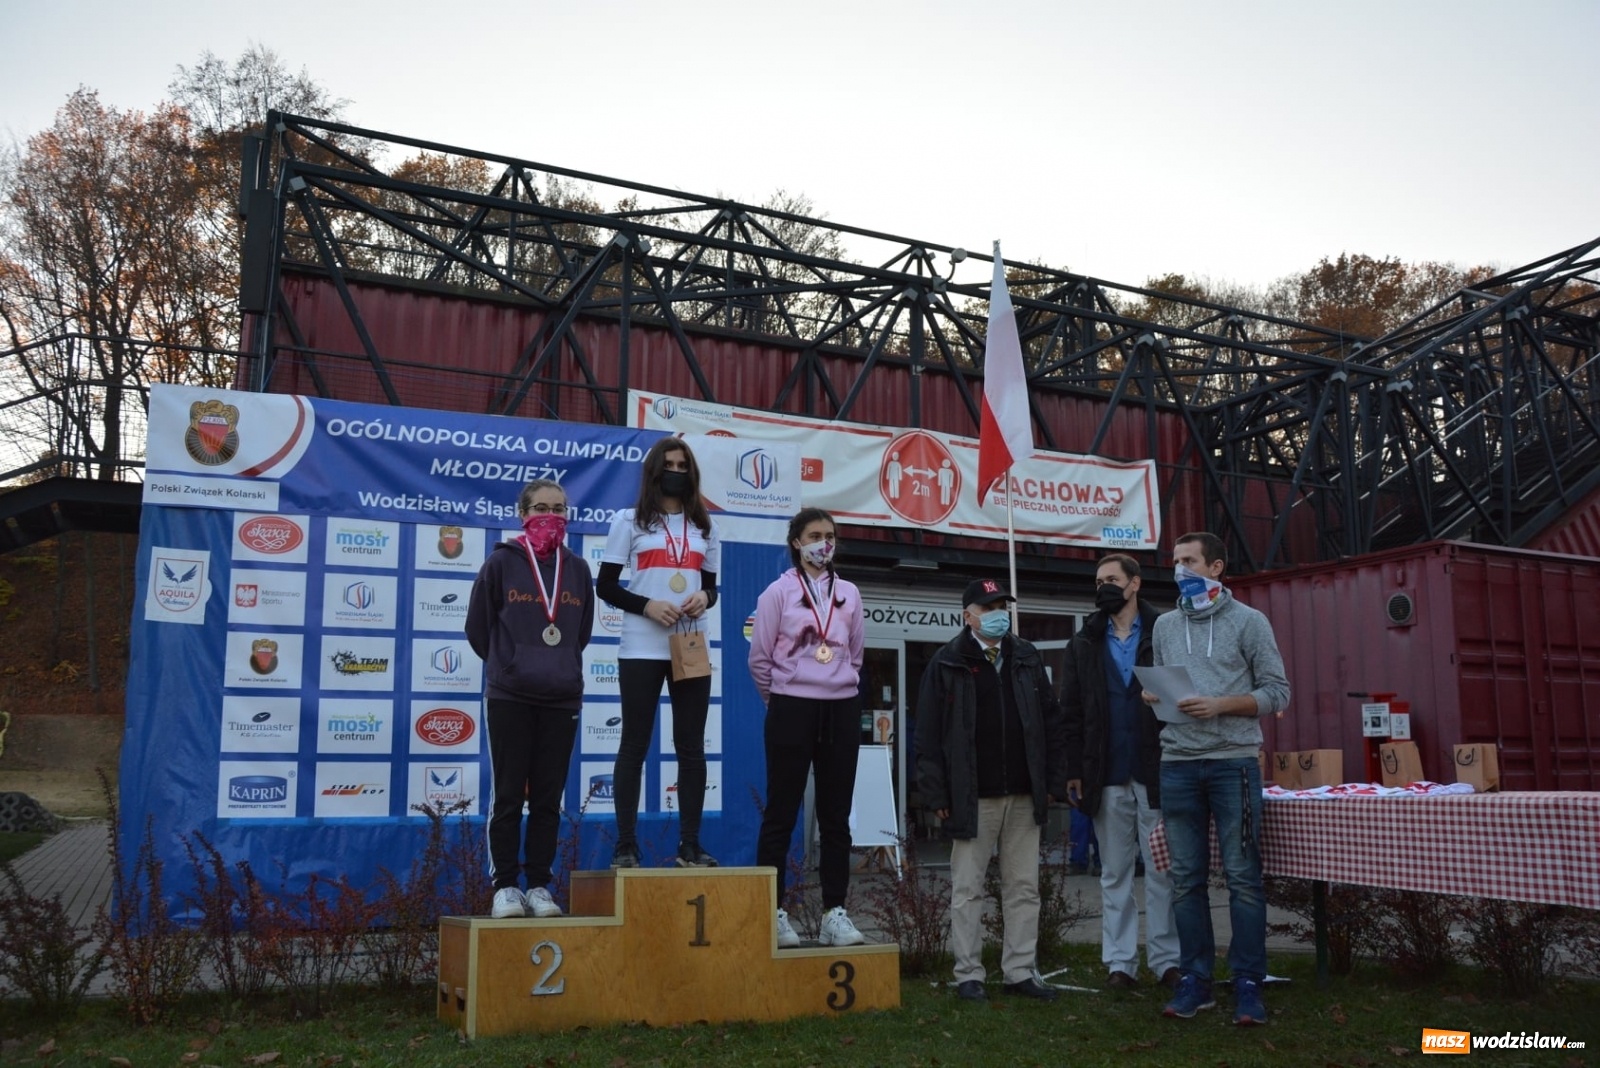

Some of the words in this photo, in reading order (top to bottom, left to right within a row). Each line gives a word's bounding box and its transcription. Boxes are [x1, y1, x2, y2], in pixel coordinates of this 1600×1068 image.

[326, 418, 527, 453] OGÓLNOPOLSKA
[430, 458, 567, 484] MŁODZIEŻY
[151, 483, 181, 493] Polski
[183, 485, 223, 498] Związek
[226, 488, 266, 500] Kolarski
[912, 479, 930, 498] 2m
[991, 474, 1124, 505] ZACHOWAJ
[358, 491, 470, 515] Wodzisław
[726, 491, 768, 501] WODZISŁAW
[769, 493, 792, 503] ŚLĄSKI
[993, 496, 1060, 516] BEPIECZNĄ
[1061, 504, 1122, 519] ODLEGŁOŚĆ!
[336, 531, 389, 547] mosir
[1102, 526, 1143, 540] mosir
[341, 546, 382, 555] centrum
[1108, 539, 1139, 547] centrum
[158, 589, 195, 599] AQUILA
[360, 657, 389, 665] TEAM
[228, 721, 294, 732] Timemaster
[328, 719, 383, 732] mosir
[333, 732, 375, 741] centrum
[230, 785, 285, 800] KAPRIN
[429, 792, 458, 800] AQUILA
[686, 893, 711, 948] 1
[529, 939, 565, 996] 2
[826, 960, 856, 1012] 3
